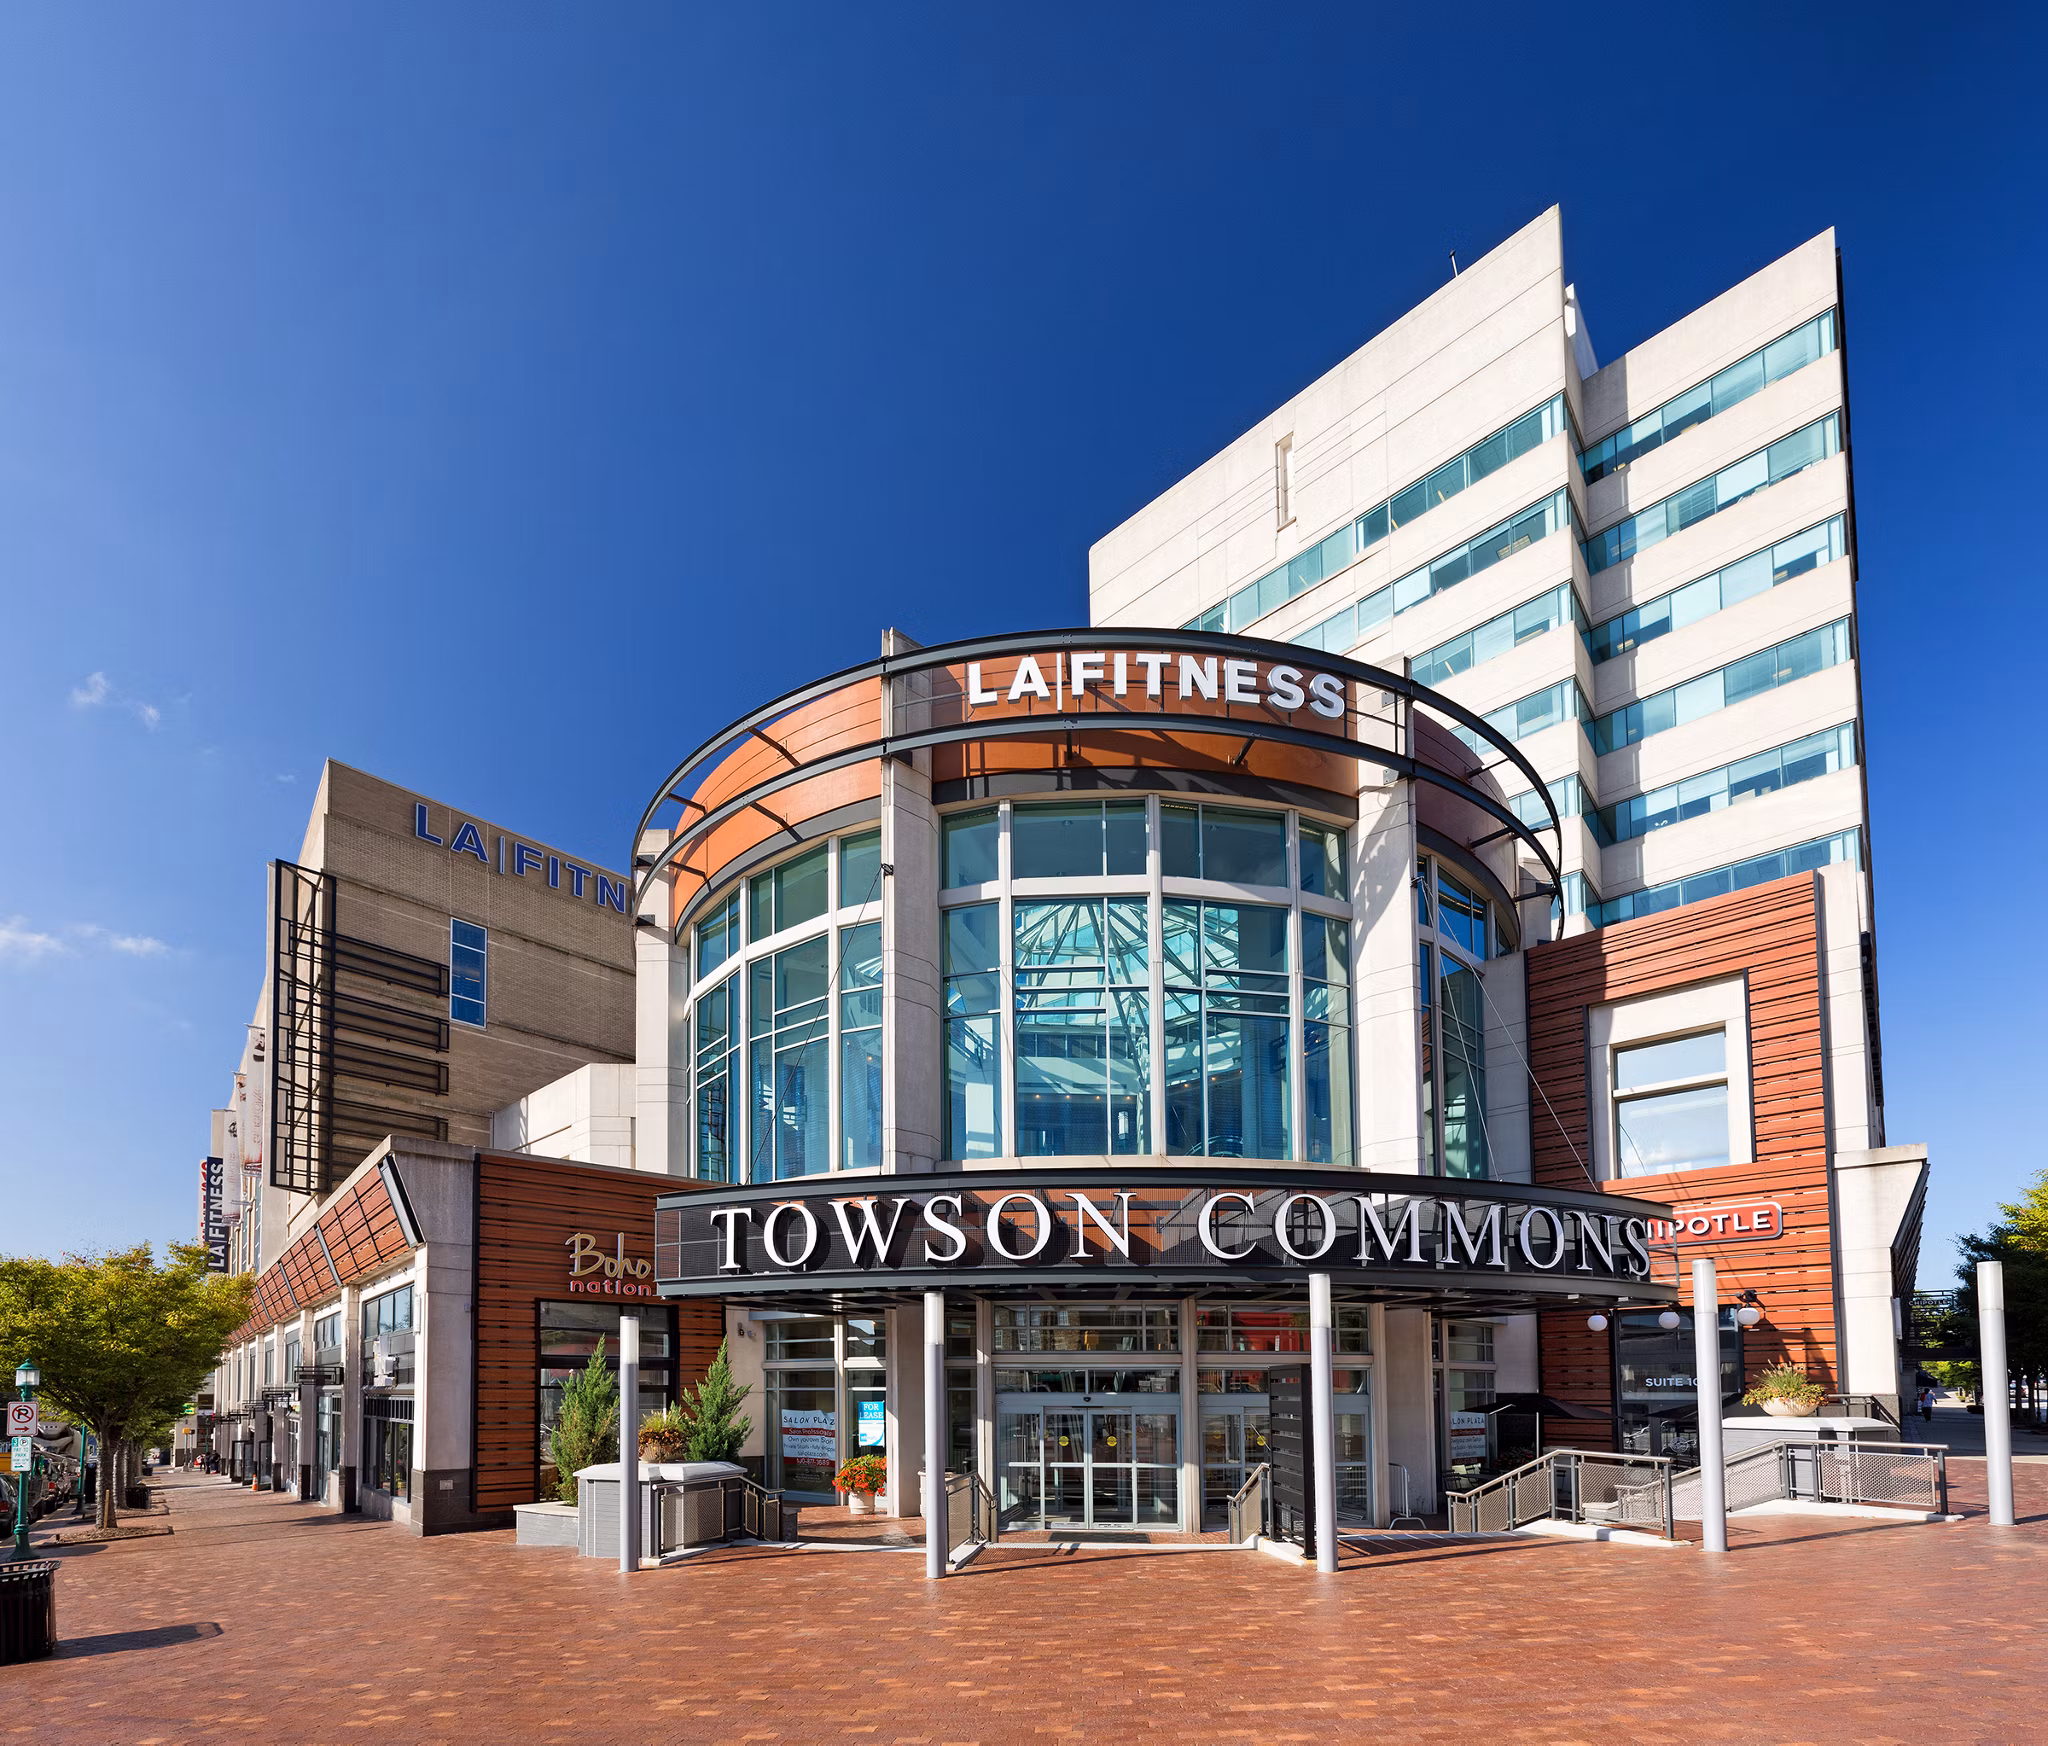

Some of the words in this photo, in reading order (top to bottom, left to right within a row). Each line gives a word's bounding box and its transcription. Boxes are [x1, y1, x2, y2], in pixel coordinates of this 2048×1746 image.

[968, 656, 1051, 705] LA
[1071, 652, 1346, 720] FITNESS
[415, 802, 490, 864] LA
[710, 1191, 1137, 1271] TOWSON
[1197, 1191, 1651, 1277] COMMONS
[565, 1232, 652, 1280] Boho
[570, 1279, 652, 1297] nation
[1645, 1377, 1683, 1387] SUITE
[784, 1416, 810, 1424] SALON
[814, 1416, 835, 1425] PLAZ
[860, 1411, 884, 1419] LEASE
